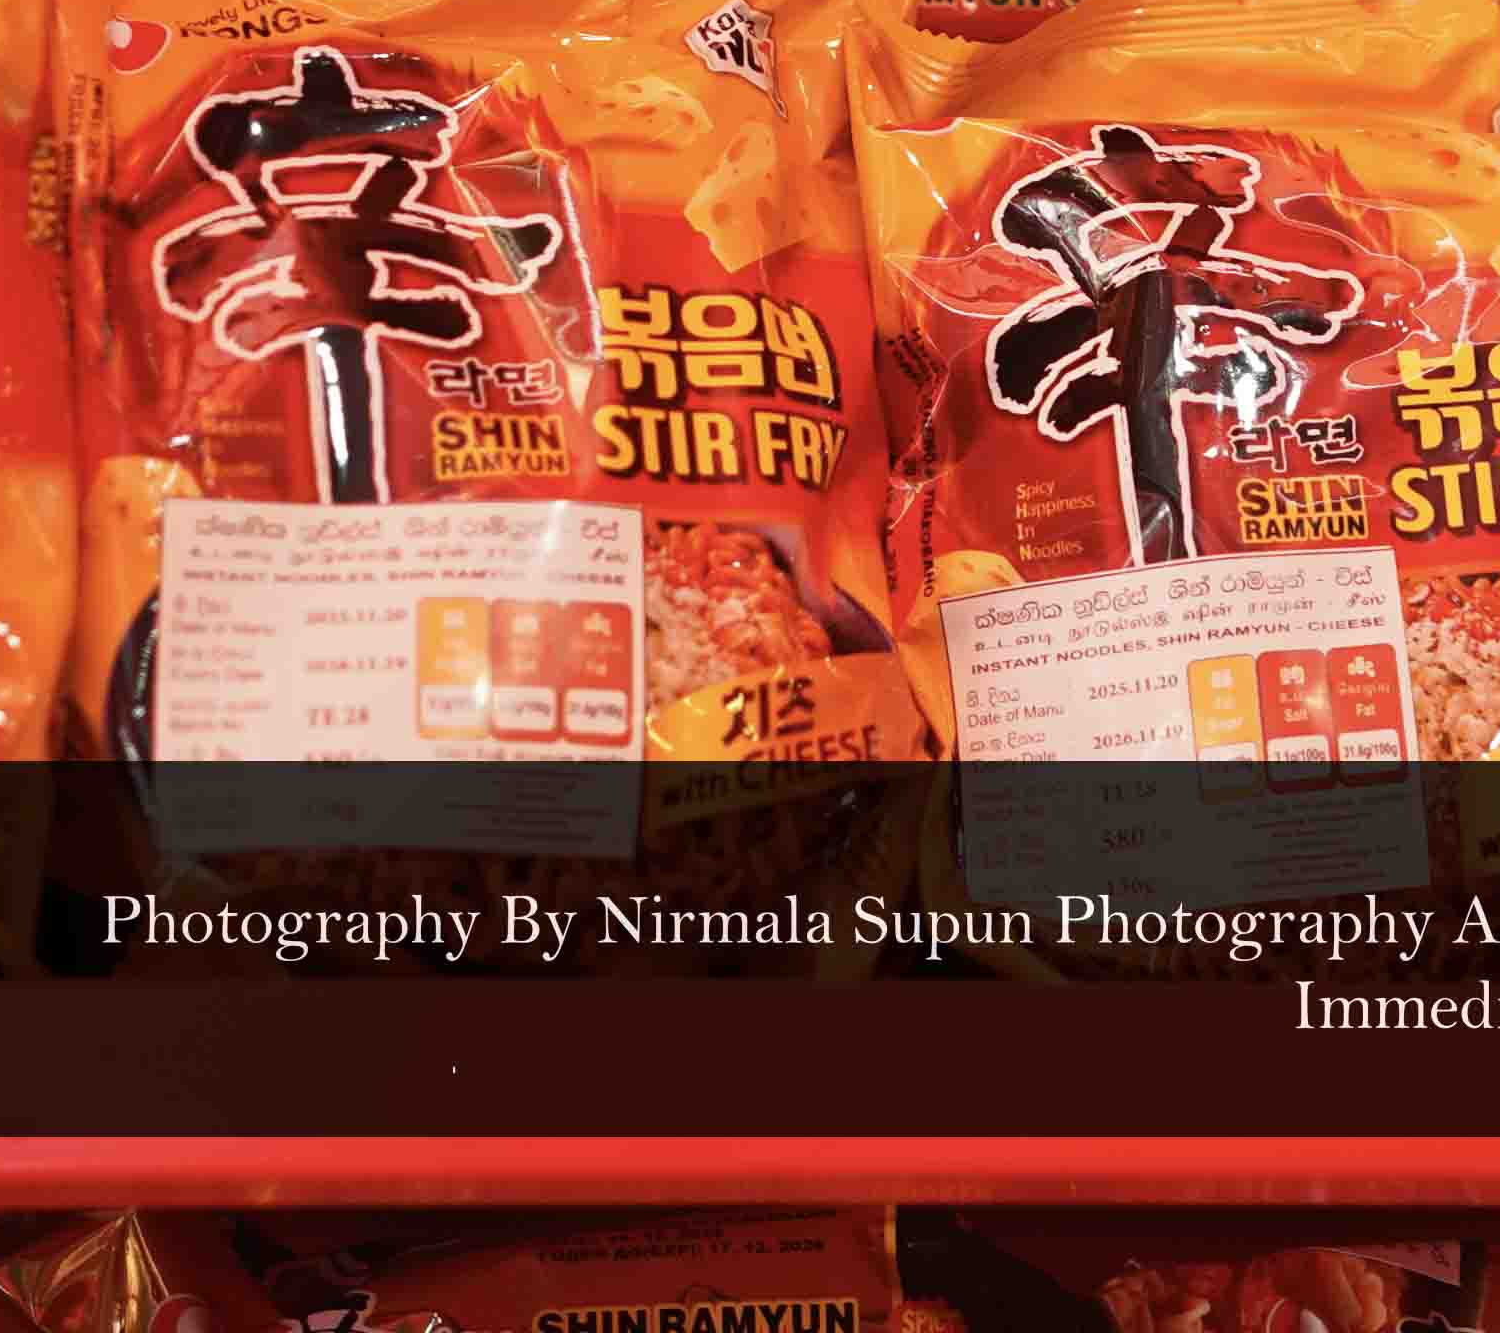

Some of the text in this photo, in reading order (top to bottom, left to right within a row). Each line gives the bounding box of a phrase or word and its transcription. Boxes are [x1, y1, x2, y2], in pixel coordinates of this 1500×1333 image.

[601, 282, 843, 409] 볶음면
[427, 358, 565, 408] 라면
[432, 412, 565, 453] SHIN
[593, 409, 850, 491] STIR FRY
[1227, 416, 1367, 473] 라면
[434, 448, 567, 479] RAMYUN
[1238, 477, 1367, 517] SHIN
[1239, 512, 1370, 545] RAMYUN
[970, 652, 1052, 676] INSTANT
[1206, 623, 1291, 642] RAMYUN
[1307, 616, 1386, 633] CHEESE
[722, 673, 818, 745] 치즈
[1087, 675, 1180, 701] 2025.11.20
